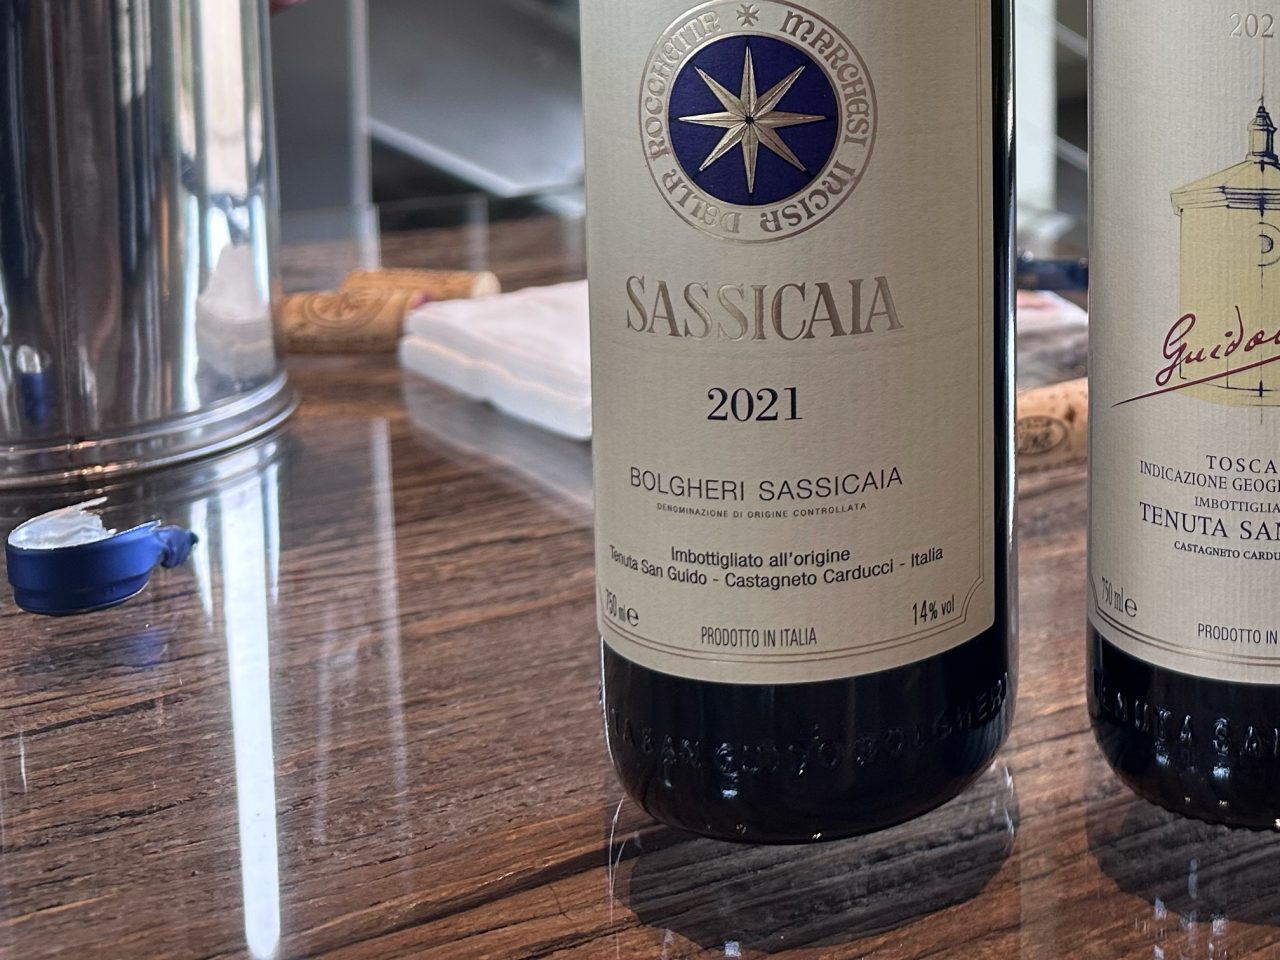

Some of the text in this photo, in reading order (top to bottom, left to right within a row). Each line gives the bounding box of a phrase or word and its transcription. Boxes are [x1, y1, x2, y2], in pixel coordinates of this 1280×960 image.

[625, 275, 905, 341] SASSICAIA
[706, 386, 803, 423] 2021
[630, 466, 904, 501] BOLGHERI SASSICAIA
[1139, 460, 1228, 490] INDICAZIONE
[656, 502, 866, 519] DENOMINAZIONE DI ORIGINE CONTROLLATA
[1139, 501, 1229, 538] TENUTA
[671, 546, 763, 570] Imbottigliato
[1174, 541, 1240, 558] CASTAGNETO
[609, 545, 638, 571] Tenuta
[641, 559, 663, 578] San
[667, 566, 707, 586] Guido
[725, 572, 817, 591] Castagneto
[823, 558, 894, 584] Carducci
[911, 547, 944, 568] Italia
[1101, 575, 1113, 607] 750
[912, 594, 955, 625] 14% vol
[701, 626, 818, 648] PRODOTTO IN ITALIA
[1197, 622, 1261, 644] PRODOTTO
[1266, 630, 1278, 645] IN
